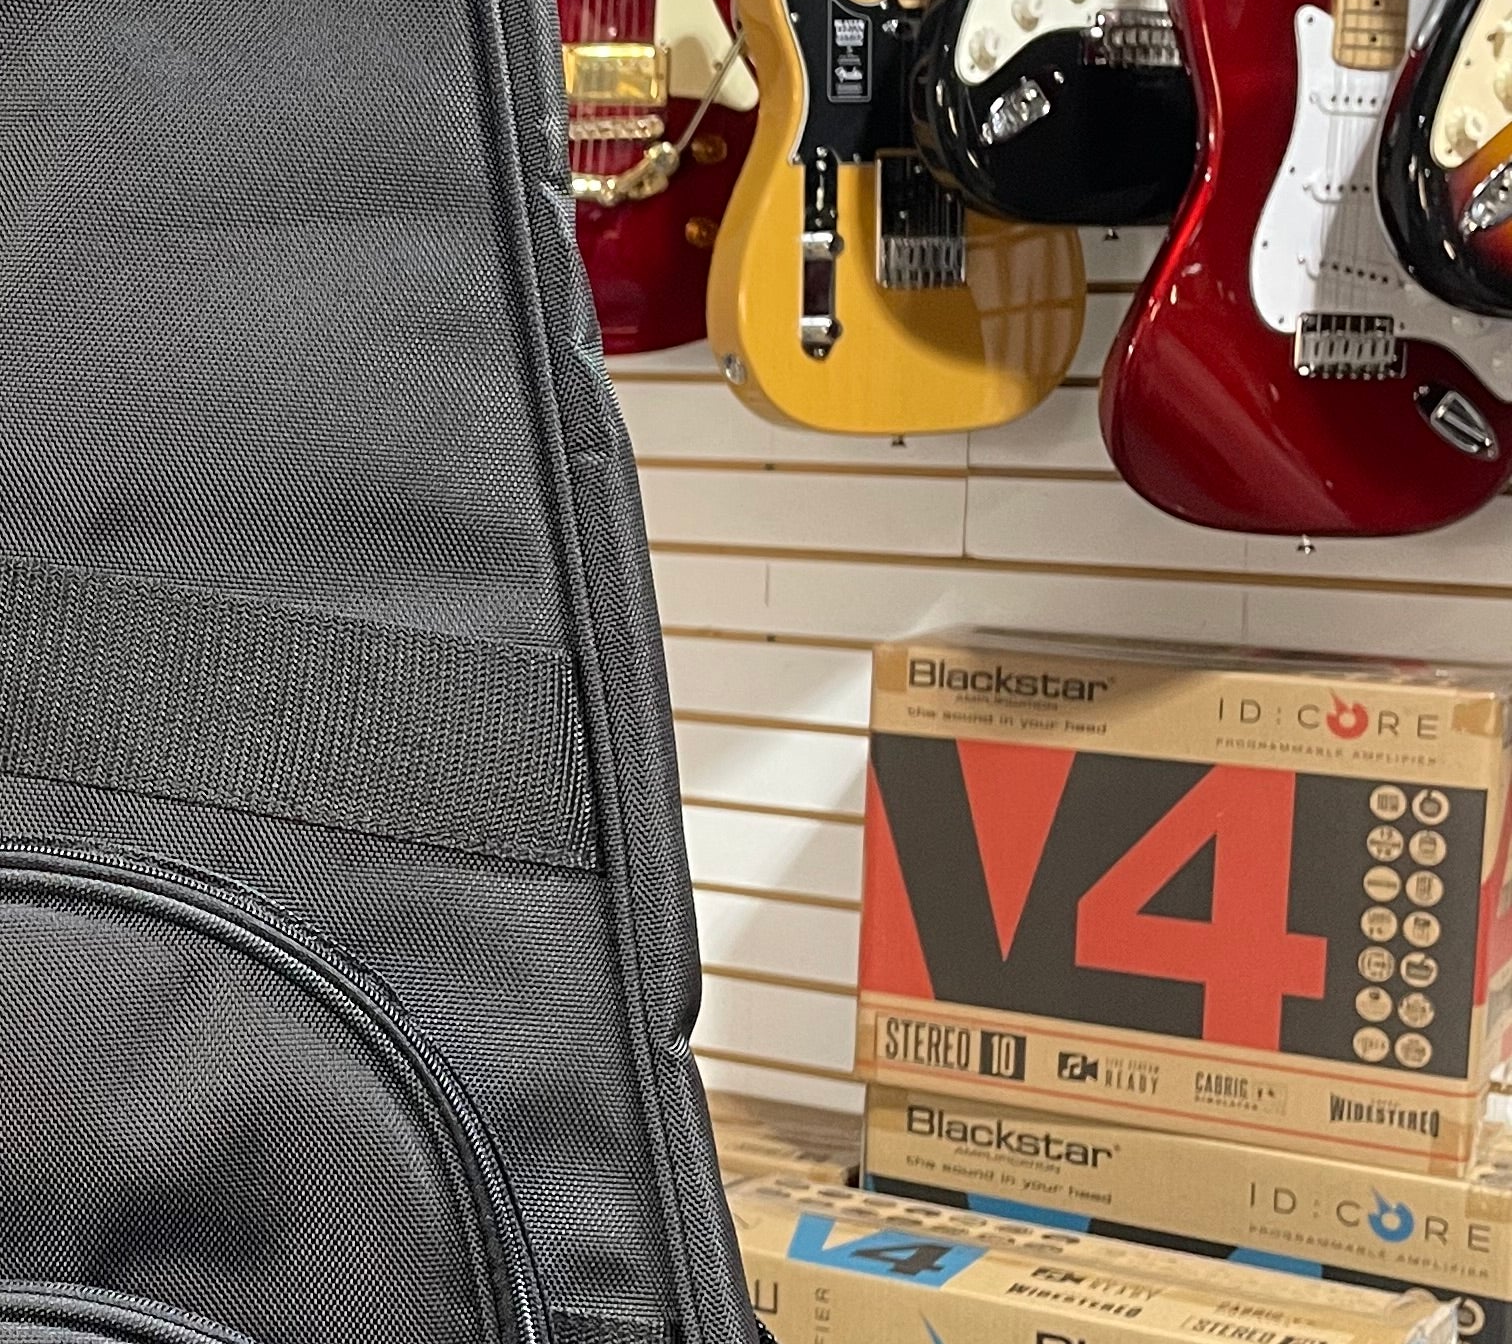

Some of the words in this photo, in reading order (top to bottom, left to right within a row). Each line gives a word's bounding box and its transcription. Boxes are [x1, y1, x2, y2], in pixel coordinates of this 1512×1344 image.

[907, 657, 1110, 703] Blackstar
[907, 706, 938, 720] the
[941, 709, 994, 727] sound
[999, 713, 1015, 728] in
[1019, 716, 1059, 733] your
[1064, 718, 1109, 735] head
[869, 732, 1328, 1053] V4
[885, 1017, 971, 1071] STEREO
[990, 1033, 1016, 1078] 10
[1104, 1068, 1160, 1096] READY
[1194, 1070, 1249, 1099] CABRIG
[906, 1104, 1114, 1169] Blackstar
[1329, 1091, 1440, 1138] WIDESTEREO
[906, 1154, 937, 1172] the
[999, 1171, 1016, 1186] in
[1021, 1176, 1064, 1196] your
[1067, 1184, 1114, 1205] head
